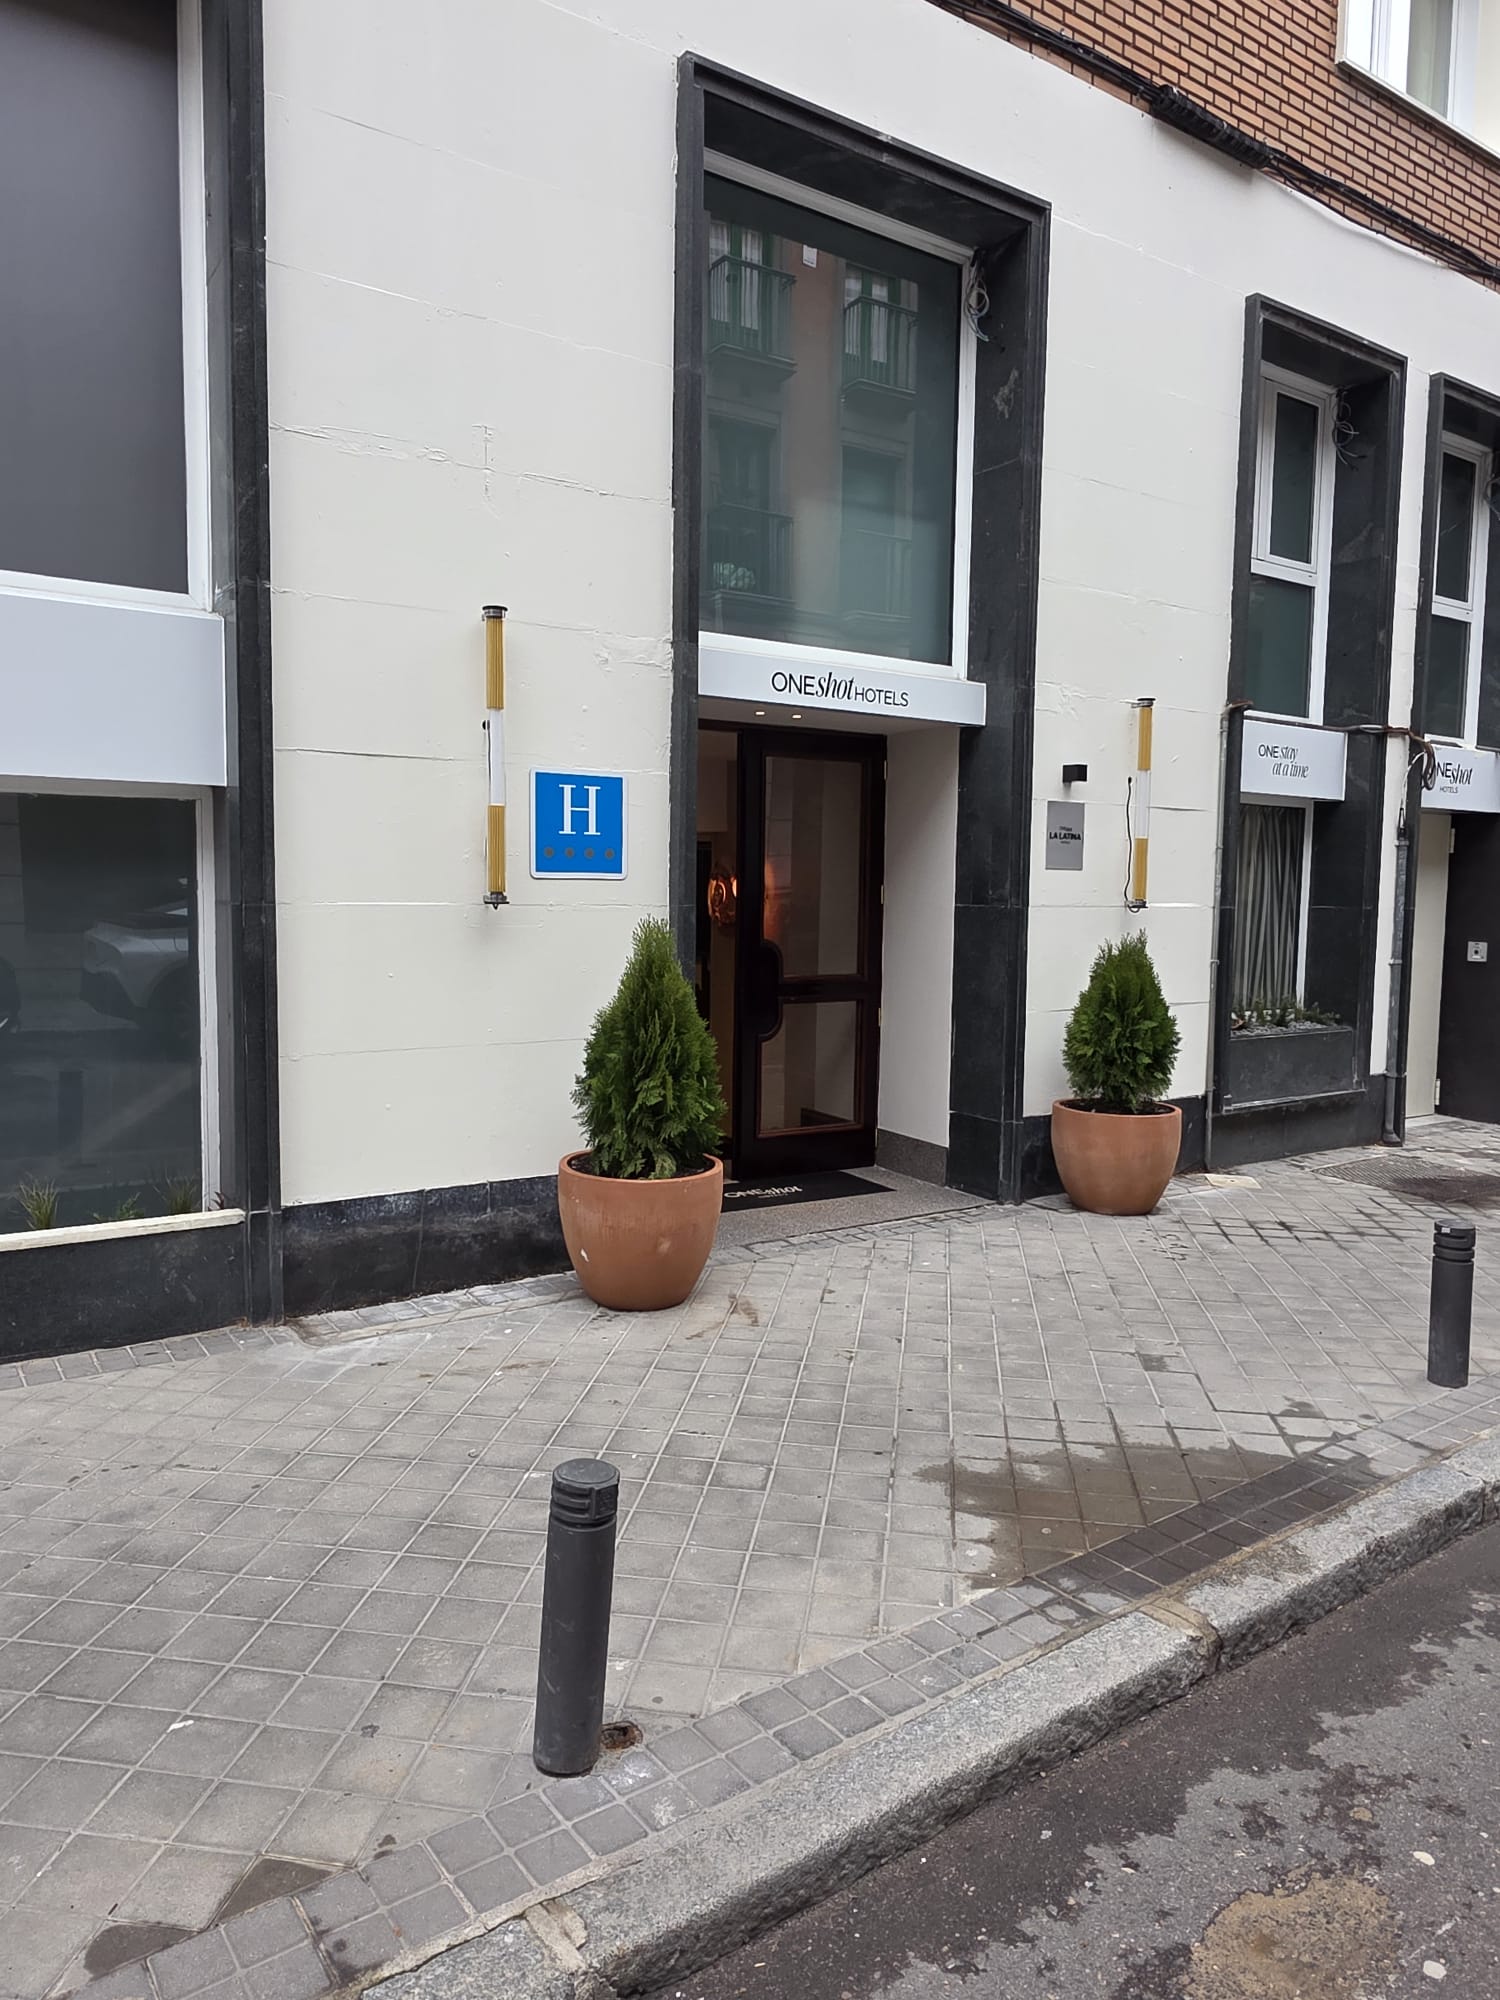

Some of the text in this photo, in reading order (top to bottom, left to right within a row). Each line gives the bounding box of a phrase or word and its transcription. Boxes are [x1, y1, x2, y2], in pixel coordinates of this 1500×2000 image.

[1258, 744, 1279, 759] ONE
[558, 783, 601, 836] H
[1049, 831, 1082, 841] LA LATINA
